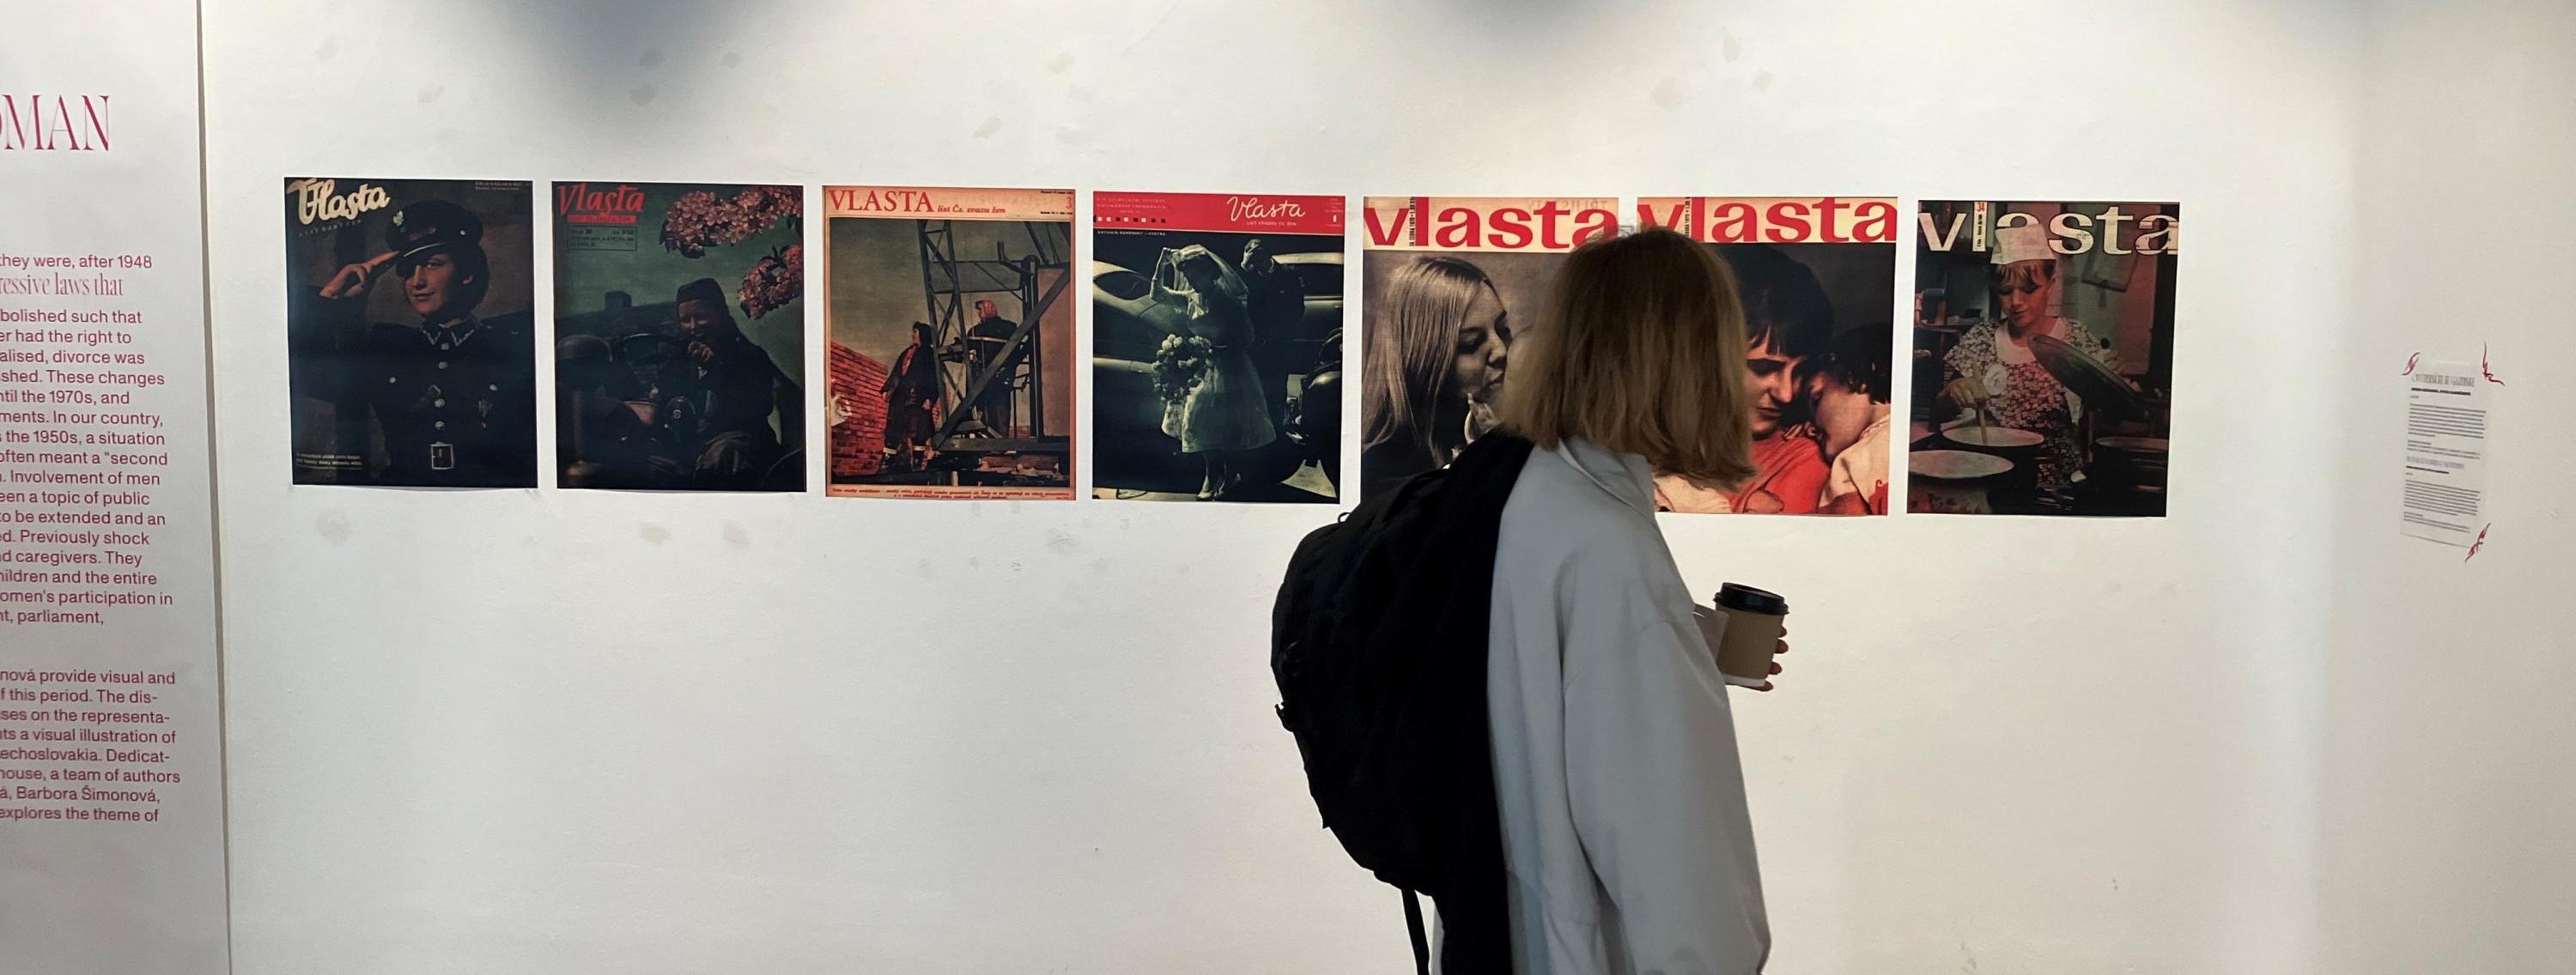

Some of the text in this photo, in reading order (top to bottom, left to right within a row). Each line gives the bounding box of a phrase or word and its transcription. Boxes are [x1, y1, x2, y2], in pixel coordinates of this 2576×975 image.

[0, 94, 110, 151] MAN
[287, 178, 391, 225] Vlasta
[558, 183, 645, 216] Vlasta
[828, 190, 934, 213] VLASTA
[1066, 197, 1072, 209] 3
[1226, 197, 1305, 221] Vlasta
[34, 257, 75, 269] were,
[80, 255, 113, 268] after
[118, 256, 152, 268] 1948
[55, 272, 89, 294] laws
[94, 273, 124, 295] that
[71, 310, 107, 323] such
[112, 311, 142, 324] that
[15, 330, 44, 342] had
[48, 330, 73, 342] the
[78, 330, 112, 346] right
[117, 332, 131, 343] to
[53, 350, 110, 363] divorce
[115, 353, 144, 364] was
[2, 370, 164, 387] shed. These changes
[22, 391, 46, 403] the
[50, 391, 96, 405] 1970s,
[101, 391, 130, 404] and
[53, 410, 66, 423] In
[70, 414, 96, 423] our
[100, 413, 163, 428] country,
[6, 430, 29, 443] the
[33, 431, 82, 445] 1950s,
[86, 434, 94, 444] a
[99, 432, 165, 445] situation
[39, 452, 88, 463] meant
[92, 455, 100, 463] a
[10, 469, 104, 484] Involvement
[108, 472, 123, 484] of
[126, 475, 161, 485] men
[29, 493, 38, 503] a
[42, 491, 80, 506] topic
[84, 491, 99, 504] of
[103, 492, 150, 507] public
[15, 510, 34, 523] be
[39, 512, 111, 524] extended
[115, 512, 143, 524] and
[148, 515, 166, 525] an
[21, 530, 100, 547] Previously
[103, 531, 149, 545] shock
[16, 551, 101, 566] caregivers.
[105, 551, 143, 567] They
[52, 571, 81, 584] and
[85, 572, 109, 584] the
[114, 572, 157, 584] entire
[58, 590, 155, 607] participation
[160, 593, 173, 605] in
[17, 609, 104, 625] parliament,
[39, 669, 97, 685] provide
[100, 671, 143, 684] visual
[148, 672, 175, 685] and
[9, 689, 36, 701] this
[39, 689, 93, 704] period.
[96, 689, 125, 703] The
[129, 691, 158, 704] dis-
[31, 712, 49, 721] on
[53, 709, 78, 722] the
[82, 711, 170, 725] representa-
[20, 731, 29, 741] a
[33, 729, 76, 742] visual
[80, 730, 158, 743] illustration
[161, 731, 176, 744] of
[106, 749, 171, 763] Dedicat-
[50, 771, 60, 780] a
[64, 769, 101, 782] team
[105, 769, 119, 782] of
[123, 771, 180, 784] authors
[16, 786, 77, 801] Barbora
[82, 785, 161, 804] Šimonová,
[65, 808, 89, 820] the
[94, 808, 140, 821] theme
[144, 809, 160, 822] of
